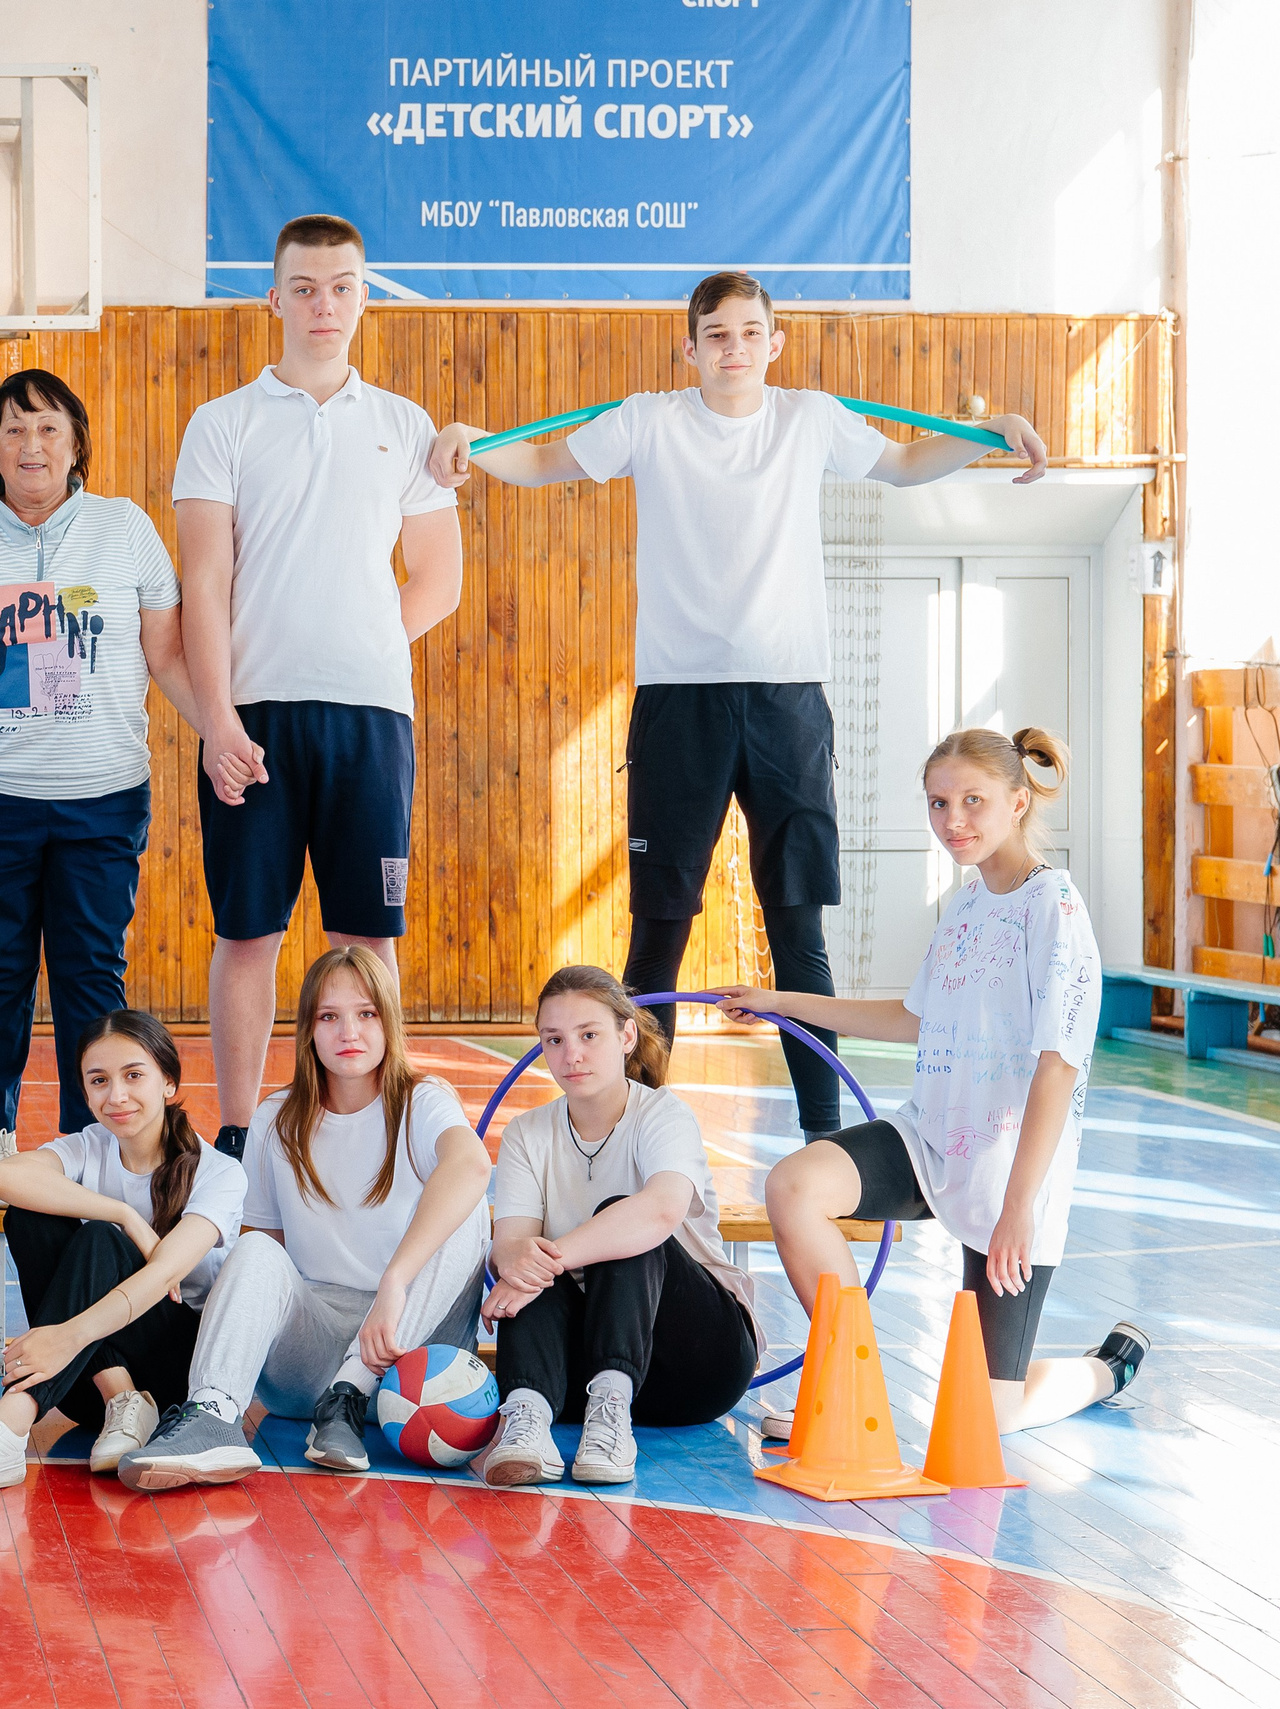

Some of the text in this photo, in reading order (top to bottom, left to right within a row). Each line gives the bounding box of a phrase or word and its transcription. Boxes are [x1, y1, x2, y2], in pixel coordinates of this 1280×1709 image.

[391, 53, 733, 88] ПАРТИЙНЫЙ ПРОЕКТ
[367, 96, 753, 144] «ДЕТСКИЙ СПОРТ»
[422, 201, 698, 227] МБОУ “Павловская СОШ”
